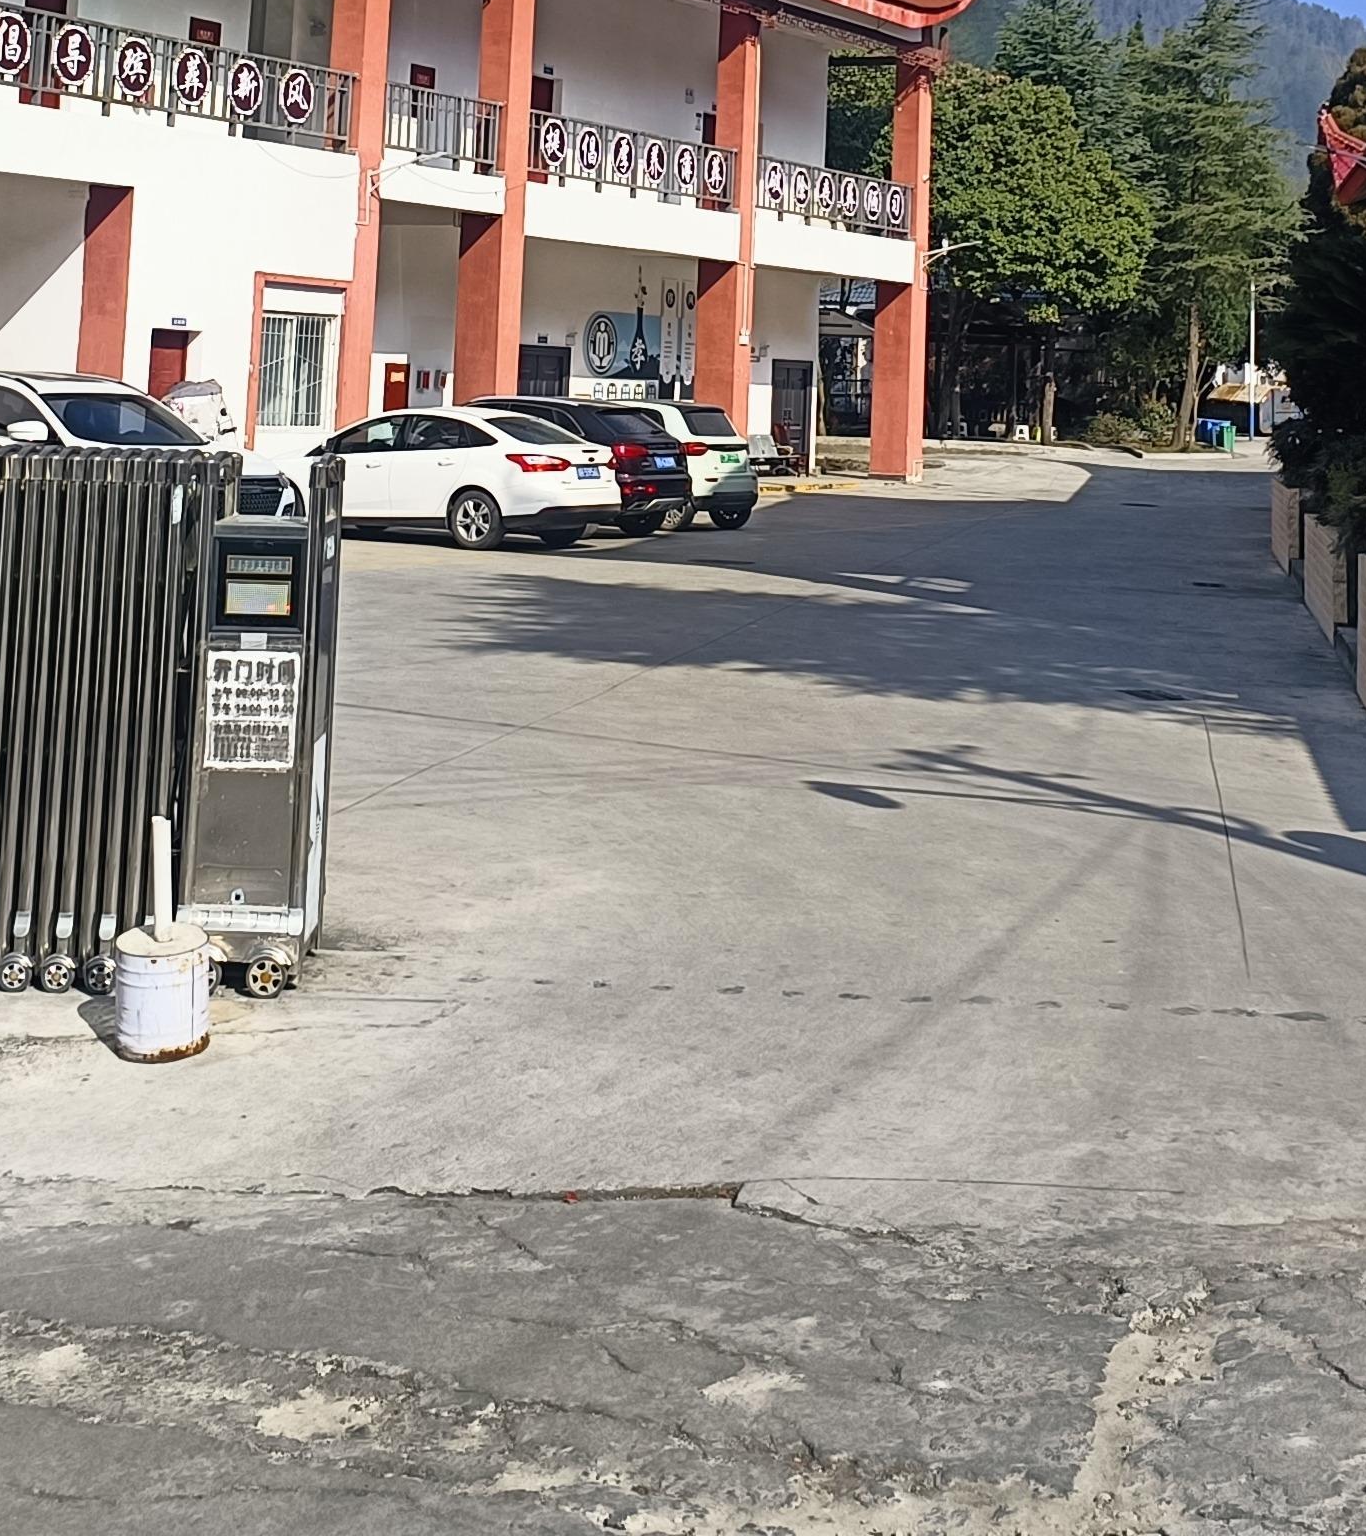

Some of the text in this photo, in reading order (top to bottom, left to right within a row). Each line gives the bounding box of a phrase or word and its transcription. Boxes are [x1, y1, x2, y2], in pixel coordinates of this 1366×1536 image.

[543, 124, 723, 190] 提倡厚养薄葬
